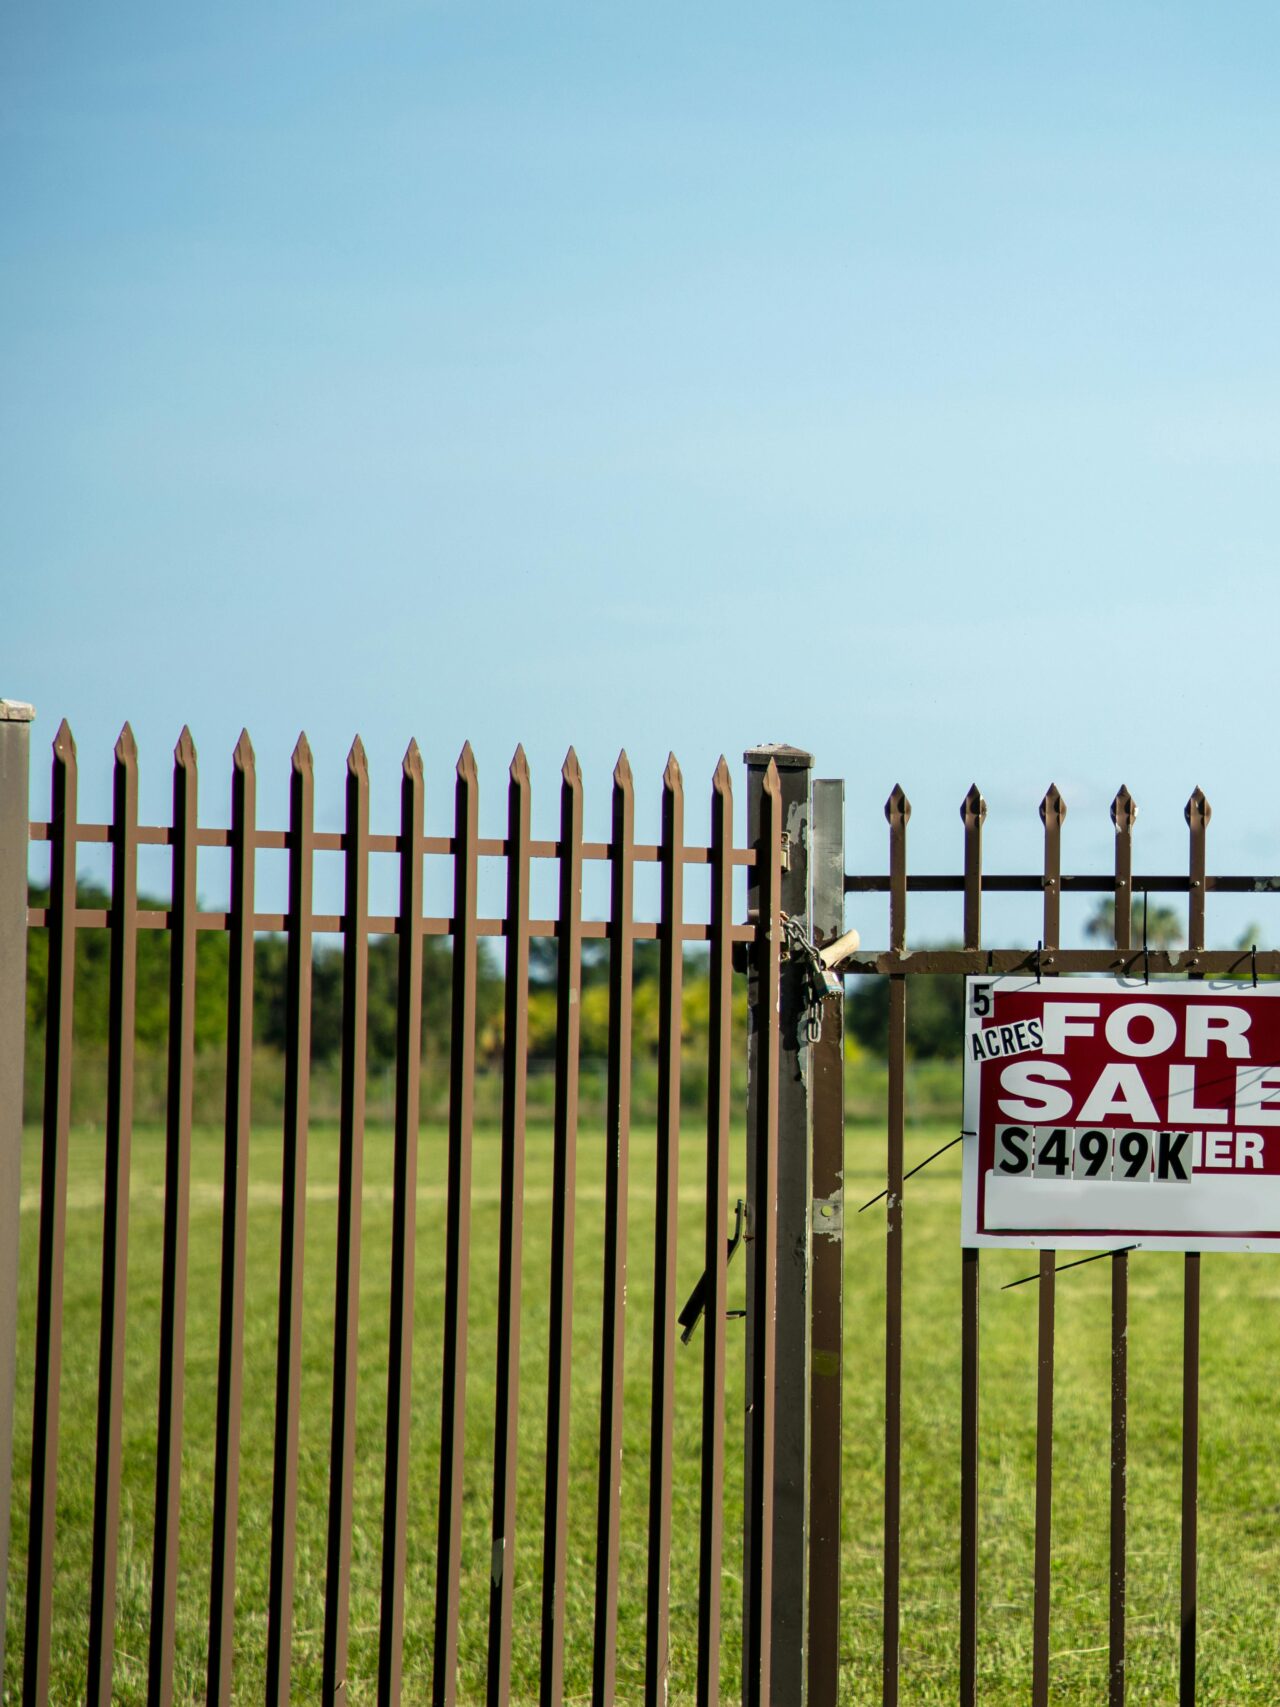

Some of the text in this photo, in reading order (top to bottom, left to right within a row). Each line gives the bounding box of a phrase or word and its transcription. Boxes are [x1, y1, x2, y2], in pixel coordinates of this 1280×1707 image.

[973, 984, 990, 1016] 5
[972, 1021, 1043, 1061] ACRES
[1042, 1001, 1252, 1059] FOR
[999, 1126, 1190, 1180] S499K
